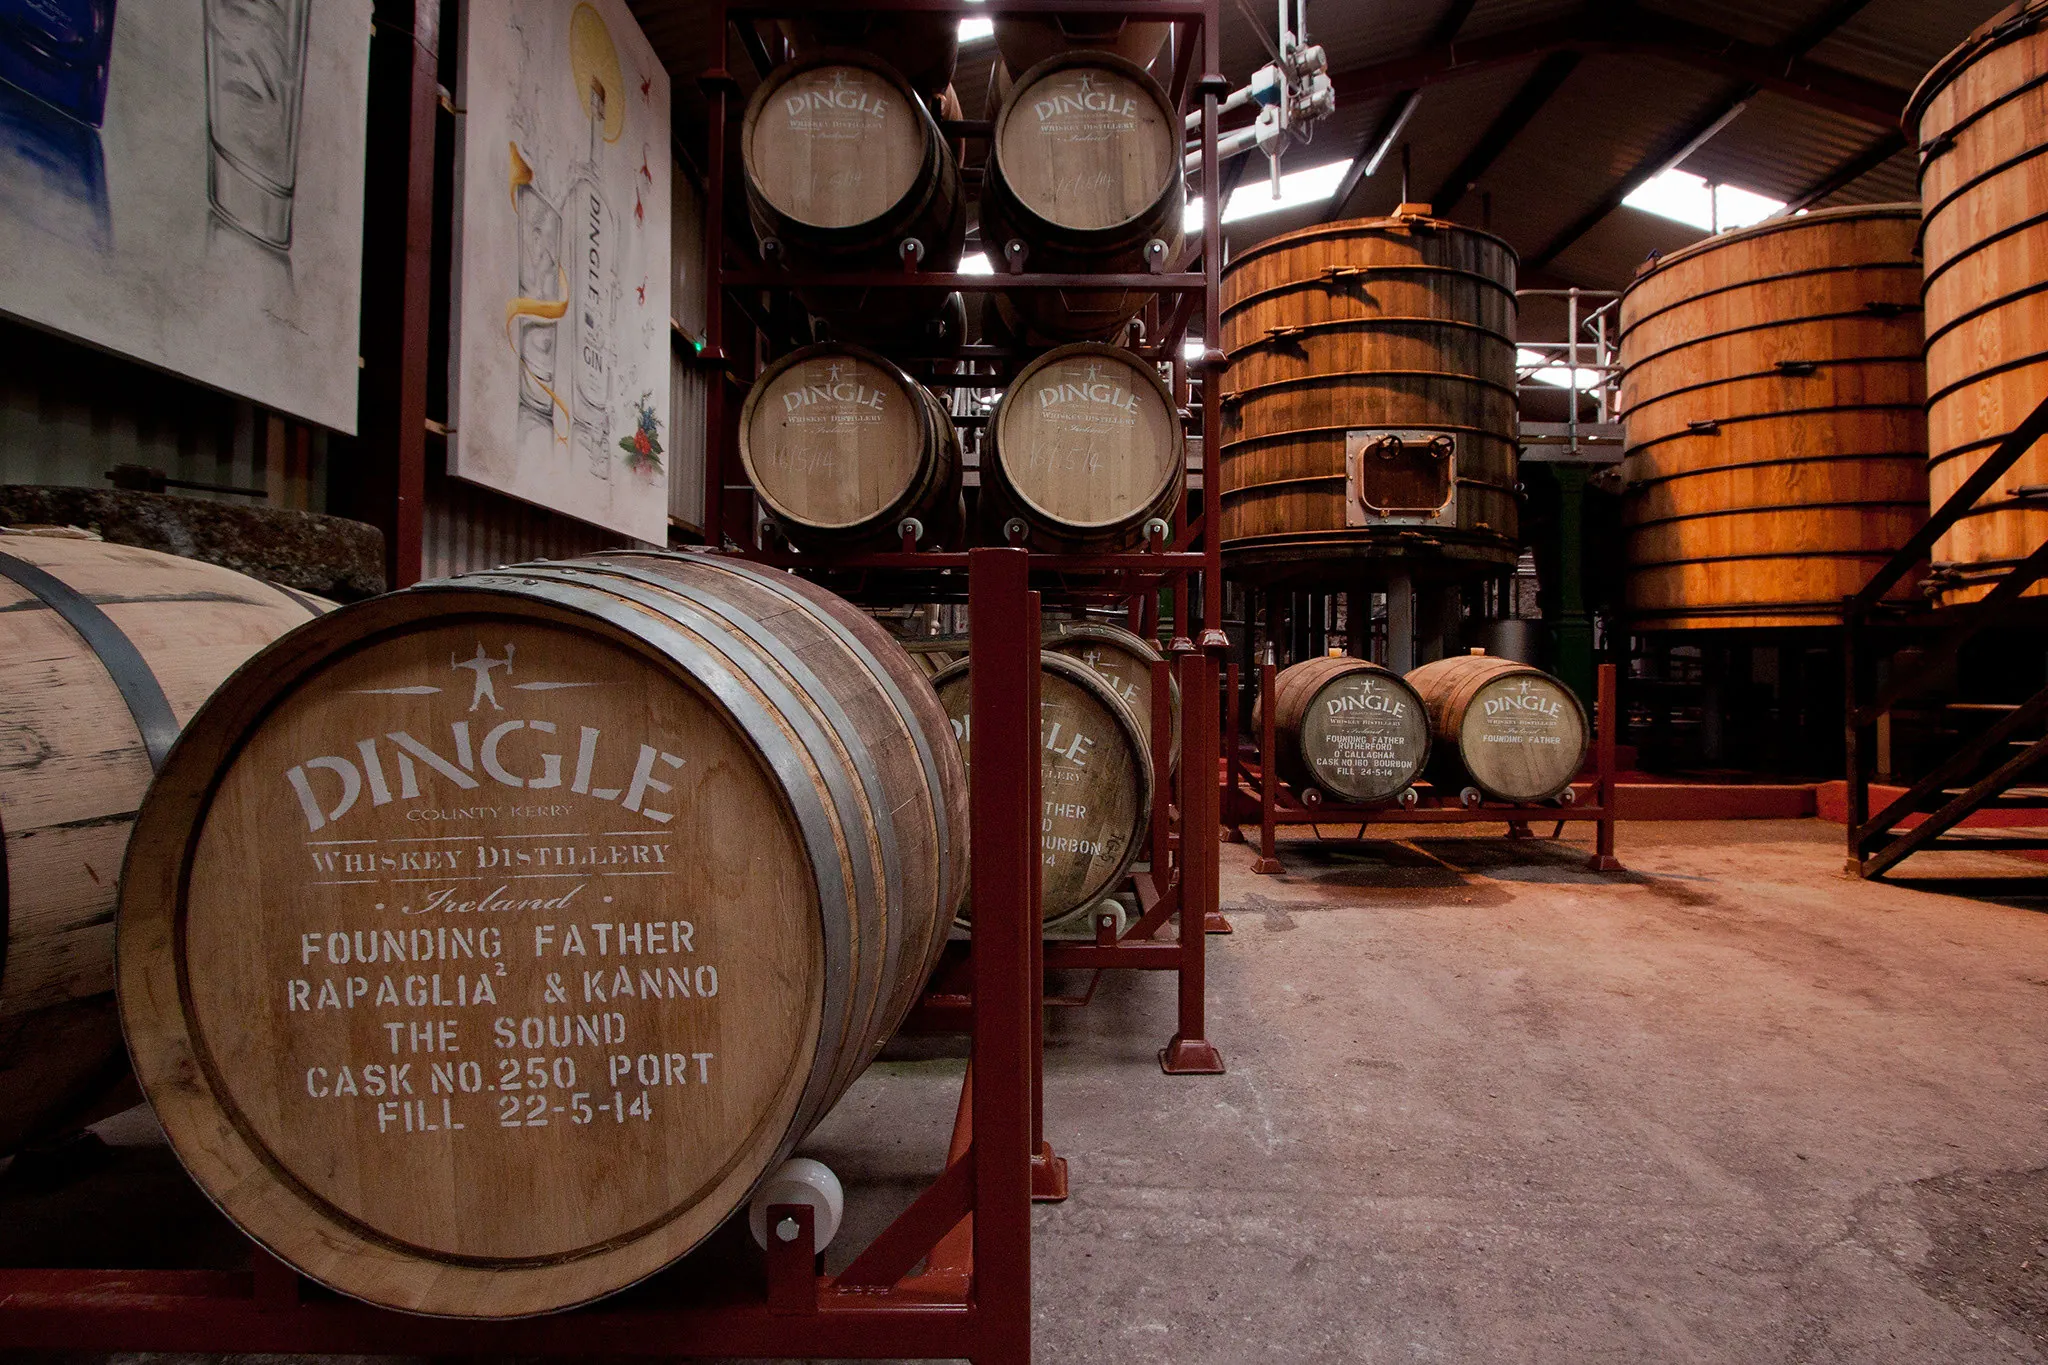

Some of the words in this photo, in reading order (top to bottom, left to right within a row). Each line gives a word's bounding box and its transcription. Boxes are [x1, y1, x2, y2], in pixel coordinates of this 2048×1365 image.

[785, 88, 888, 119] DINGLE
[1034, 92, 1138, 121] DINGLE
[588, 193, 602, 305] DINGLE
[583, 346, 603, 374] GIN
[782, 383, 887, 412] DINGLE
[1038, 383, 1142, 415] DINGLE
[1326, 694, 1406, 718] DINGLE
[1483, 695, 1563, 718] DINGLE
[1326, 735, 1367, 744] FOUNDING
[1372, 736, 1405, 745] FATHER
[1338, 742, 1393, 751] RUTHERFORD
[1483, 734, 1523, 743] FOUNDING
[1528, 736, 1561, 744] FATHER
[1316, 758, 1339, 766] CASK
[1374, 759, 1413, 769] BOURBON
[1344, 750, 1396, 759] CALLAGHAN
[286, 719, 687, 833] DINGLE
[1337, 767, 1355, 775] FILL
[406, 806, 499, 822] COUNTY
[511, 804, 574, 818] KERRY
[312, 850, 463, 873] WHISKEY
[477, 843, 672, 869] DISTILLERY
[402, 883, 587, 915] Ireland
[301, 926, 502, 965] FOUNDING
[535, 920, 696, 957] FATHER
[544, 972, 568, 1004] &
[583, 965, 719, 1003] KANNO
[383, 1020, 460, 1054] THE
[493, 1012, 627, 1050] SOUND
[306, 1063, 413, 1099] CASK
[609, 1052, 714, 1088] PORT
[377, 1099, 465, 1134] FILL
[500, 1090, 653, 1128] 22-5-14
